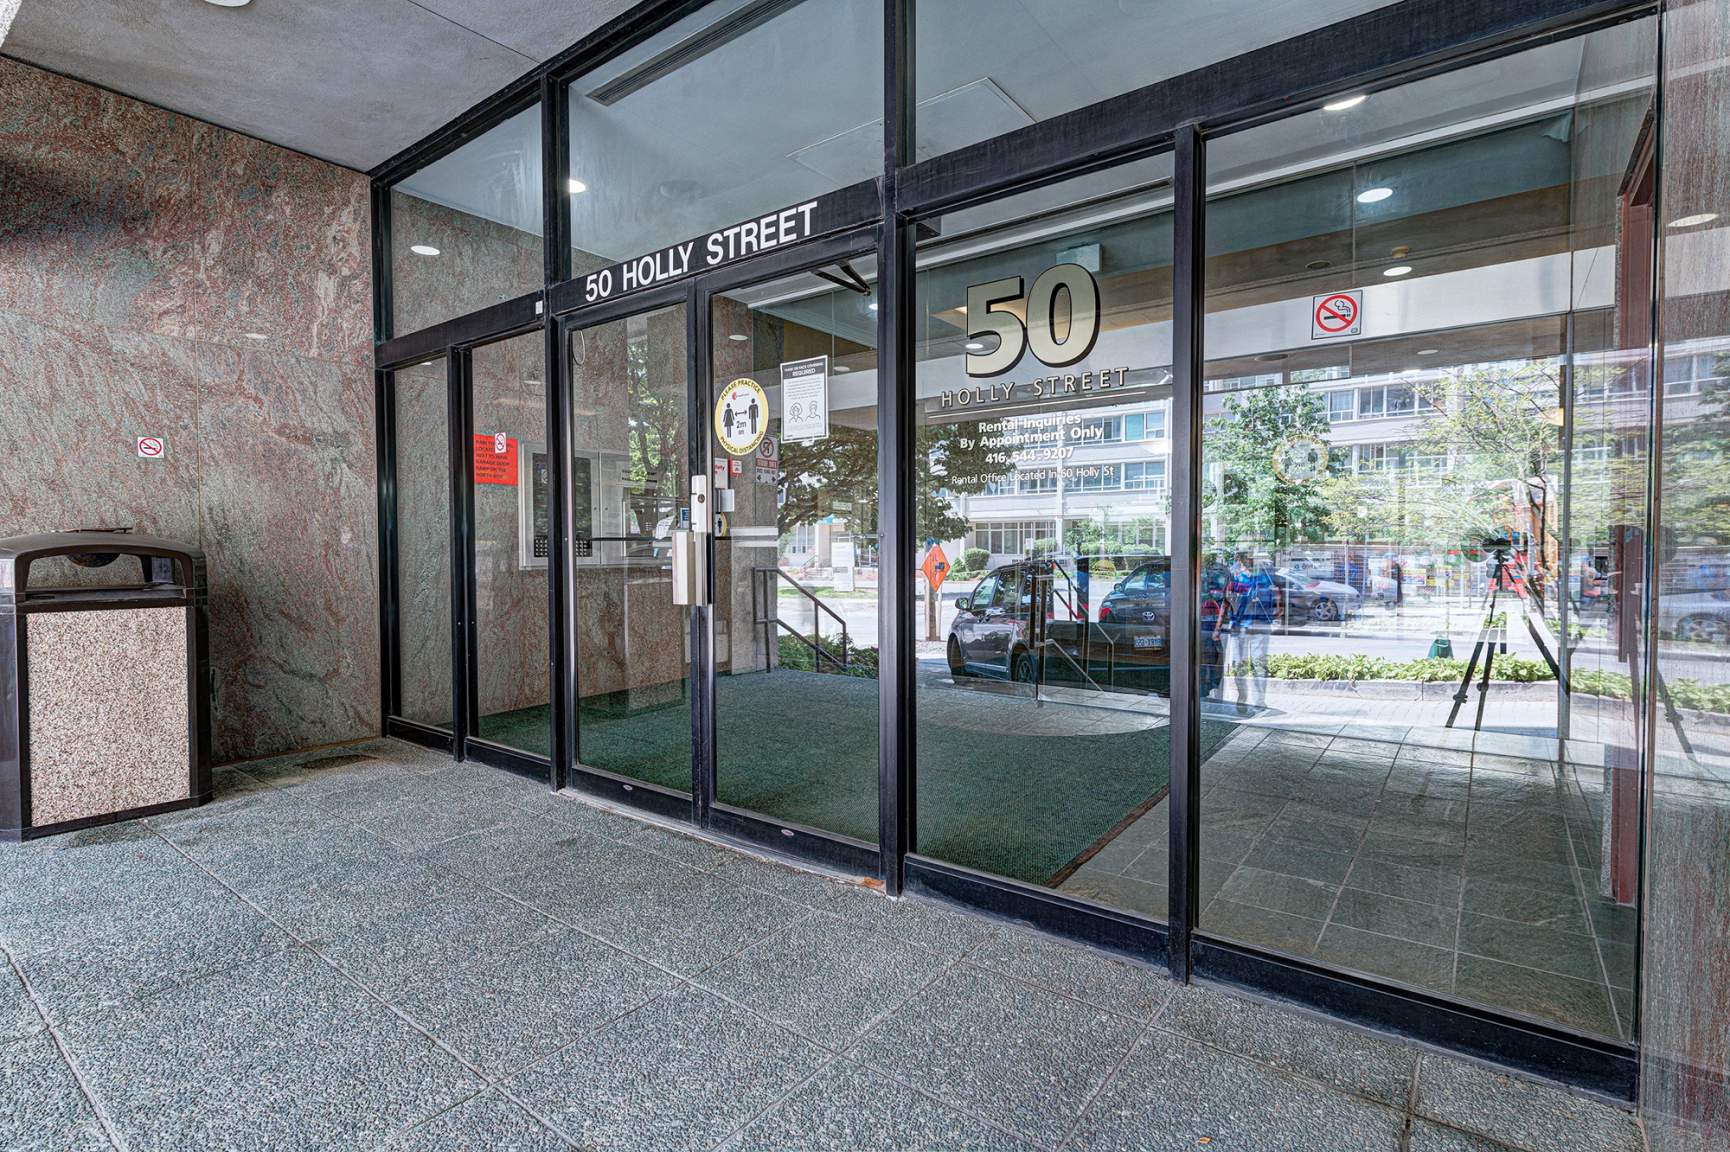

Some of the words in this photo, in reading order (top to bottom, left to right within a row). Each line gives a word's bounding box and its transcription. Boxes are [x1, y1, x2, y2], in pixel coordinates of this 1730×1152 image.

[585, 269, 612, 301] 50
[623, 242, 694, 291] HOLLY
[706, 201, 818, 265] STREET
[966, 263, 1100, 378] 50
[721, 382, 736, 400] PLEASE
[738, 380, 760, 393] PRACTICE
[941, 382, 1015, 408] HOLLY
[1033, 367, 1129, 396] STREET
[736, 420, 747, 429] 2m
[979, 418, 1018, 433] Rental
[1023, 412, 1081, 429] Inquiries
[720, 436, 738, 453] PHYSICAL
[738, 431, 764, 453] DISTANCING
[960, 438, 975, 450] By
[980, 429, 1065, 448] Appointment
[1071, 425, 1103, 440] Only
[951, 473, 978, 485] Rental
[980, 472, 1007, 483] Office
[1009, 470, 1046, 481] Located
[1076, 466, 1100, 478] Holly
[1103, 465, 1114, 476] St
